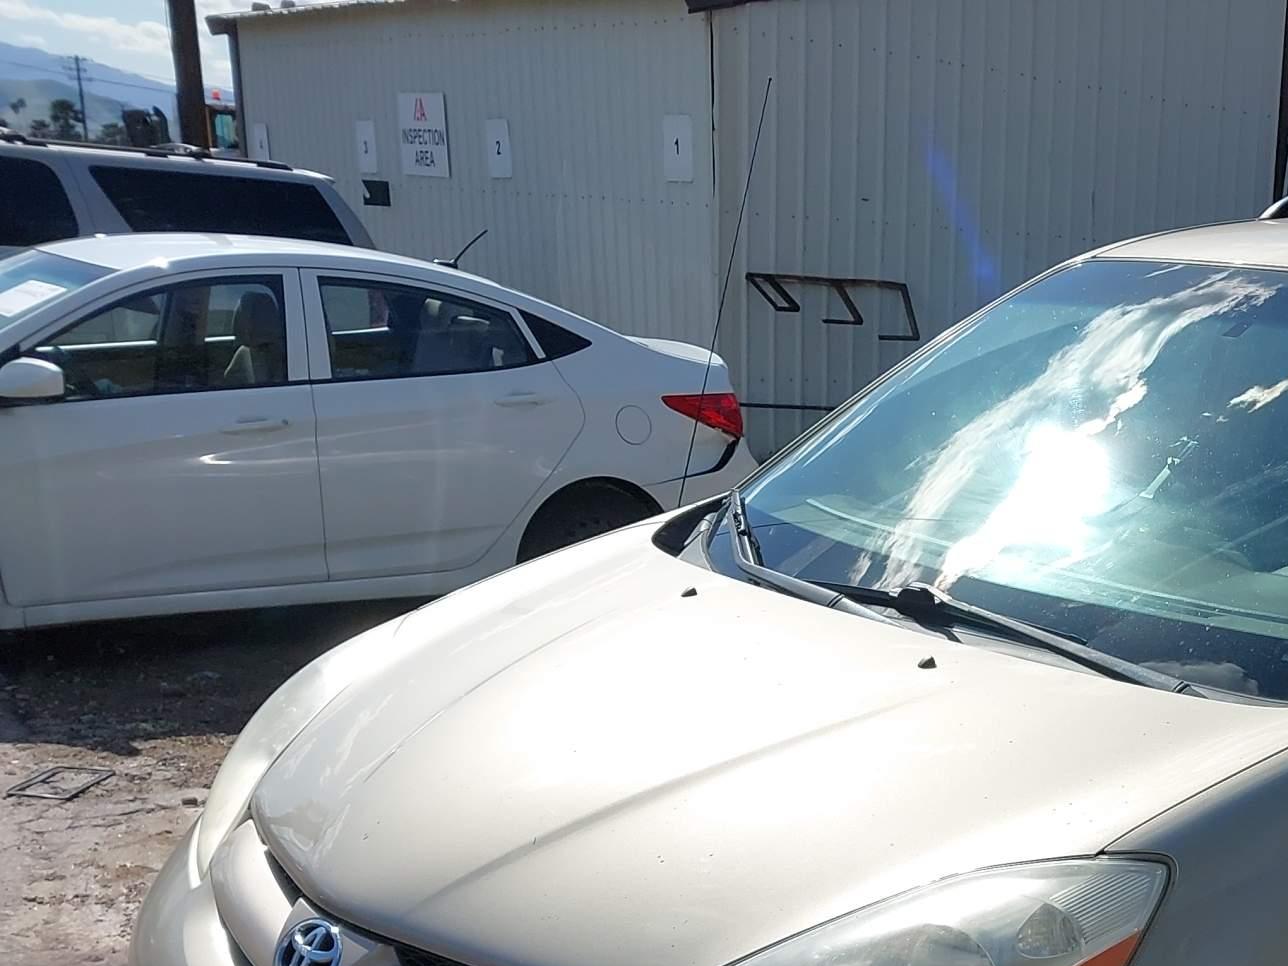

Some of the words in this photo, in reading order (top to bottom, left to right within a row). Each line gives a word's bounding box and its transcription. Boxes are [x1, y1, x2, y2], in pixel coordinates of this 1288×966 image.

[402, 128, 446, 146] INSPECTION
[495, 139, 503, 157] 2
[674, 137, 681, 156] 1
[415, 150, 436, 168] AREA
